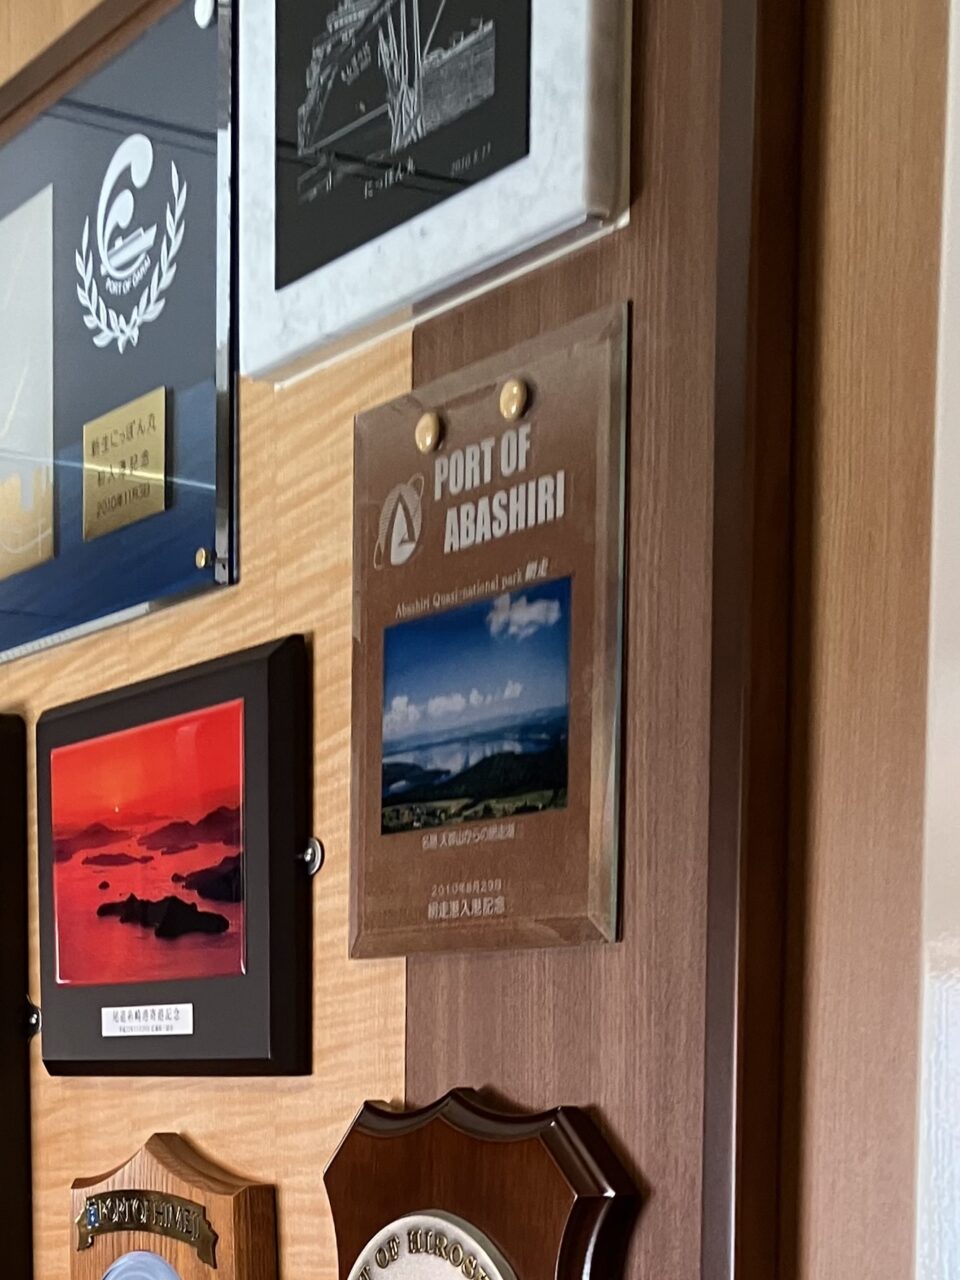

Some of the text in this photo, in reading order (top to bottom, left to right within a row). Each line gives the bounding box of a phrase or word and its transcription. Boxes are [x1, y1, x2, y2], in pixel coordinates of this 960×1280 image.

[434, 422, 532, 501] PORT OF
[443, 471, 565, 553] ABASHIRI
[395, 594, 430, 619] Abashiri
[375, 1237, 401, 1269] OF
